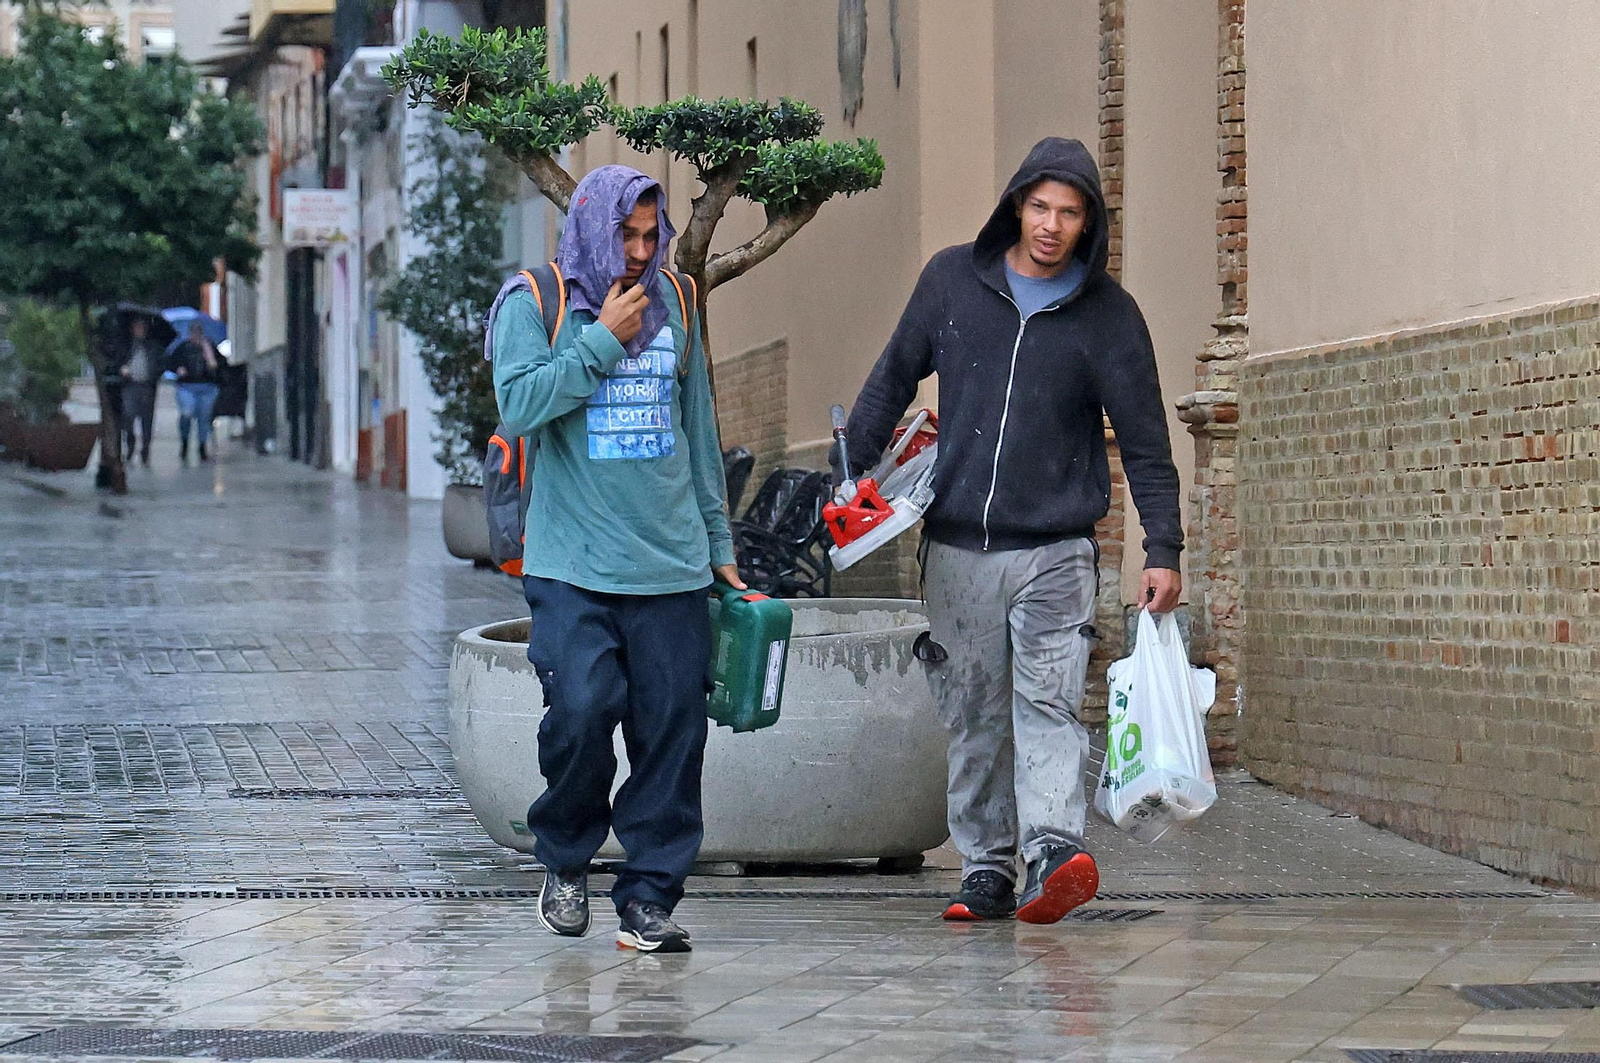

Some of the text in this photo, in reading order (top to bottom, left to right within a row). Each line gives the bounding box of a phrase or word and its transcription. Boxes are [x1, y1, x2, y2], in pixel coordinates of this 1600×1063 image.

[615, 358, 652, 371] NEW
[611, 384, 655, 398] YORK
[618, 409, 654, 423] CITY
